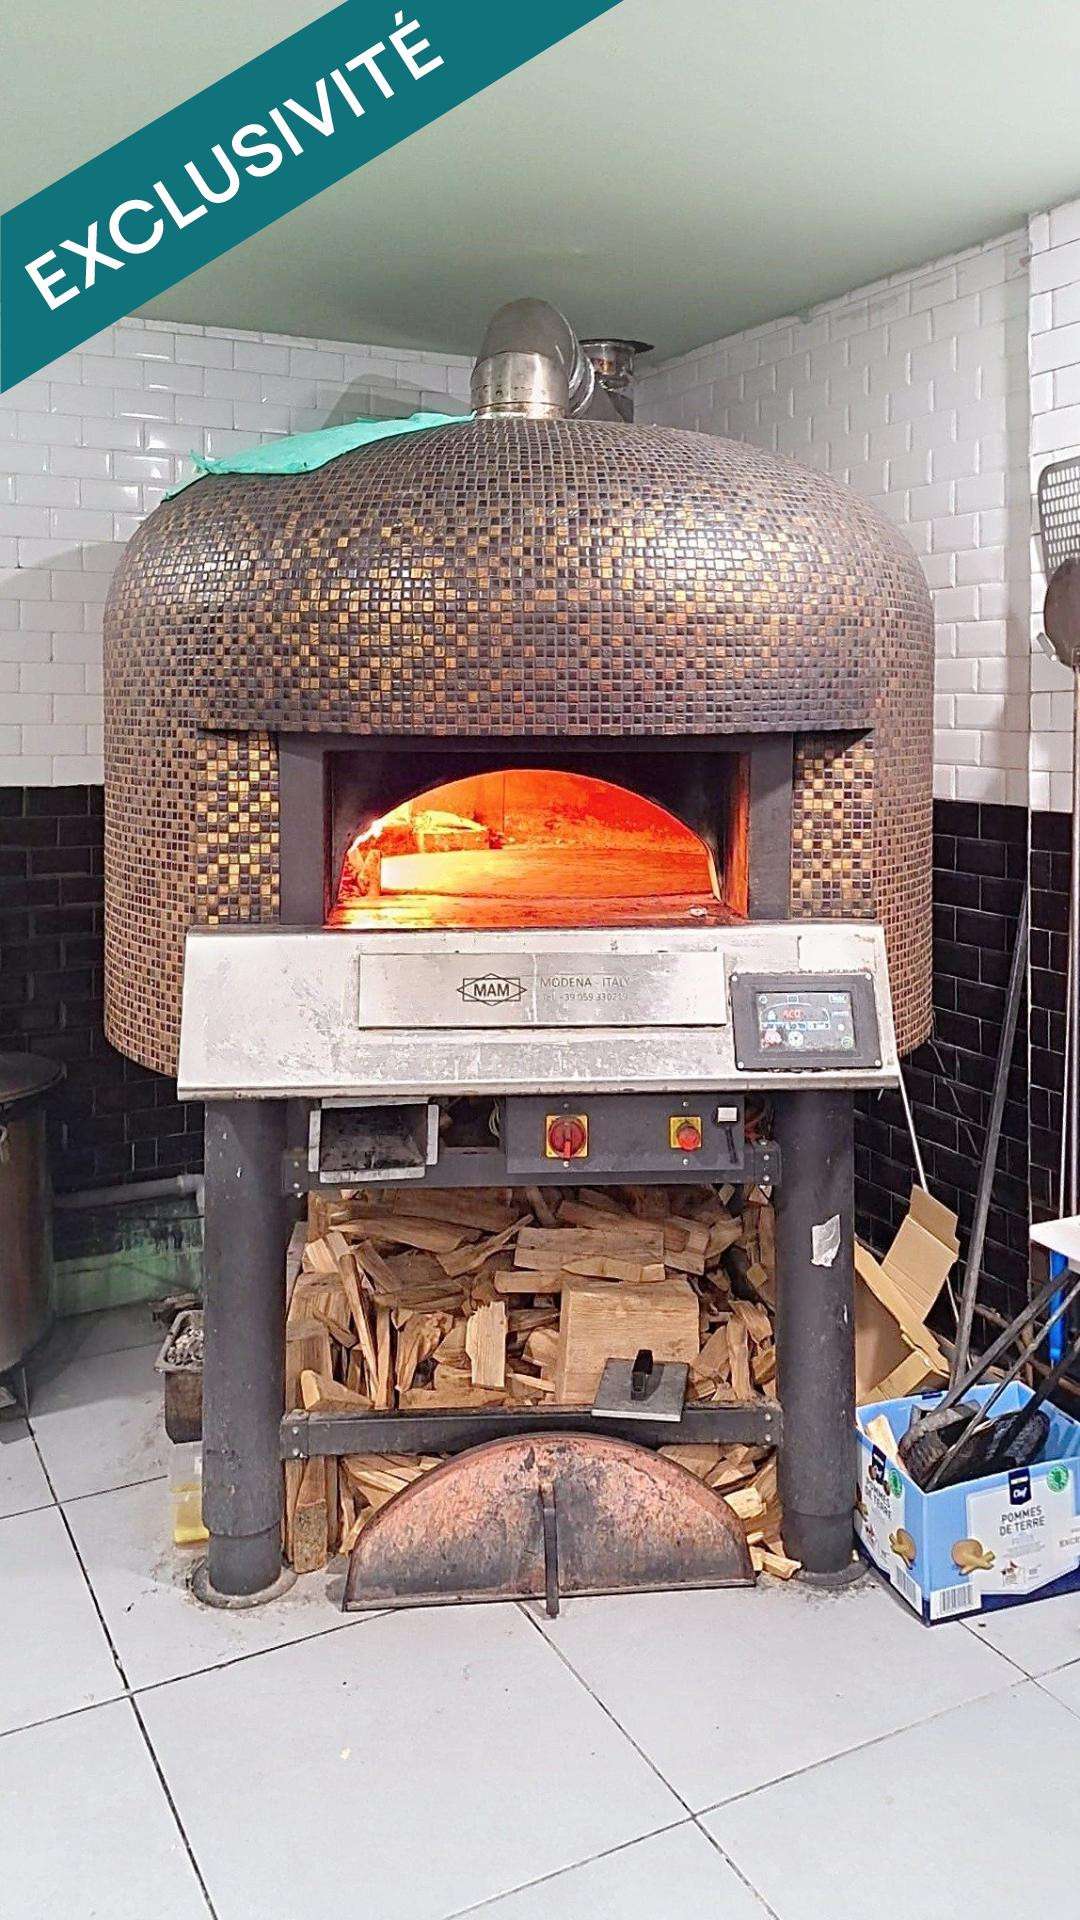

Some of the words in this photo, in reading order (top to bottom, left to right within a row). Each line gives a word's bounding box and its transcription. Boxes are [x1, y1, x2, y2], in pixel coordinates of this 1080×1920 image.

[473, 983, 510, 997] MAM
[540, 976, 592, 988] MODENA
[601, 976, 630, 988] ITALY
[1001, 1505, 1043, 1525] POMMES
[999, 1524, 1012, 1537] DE
[1015, 1515, 1046, 1533] TERRE
